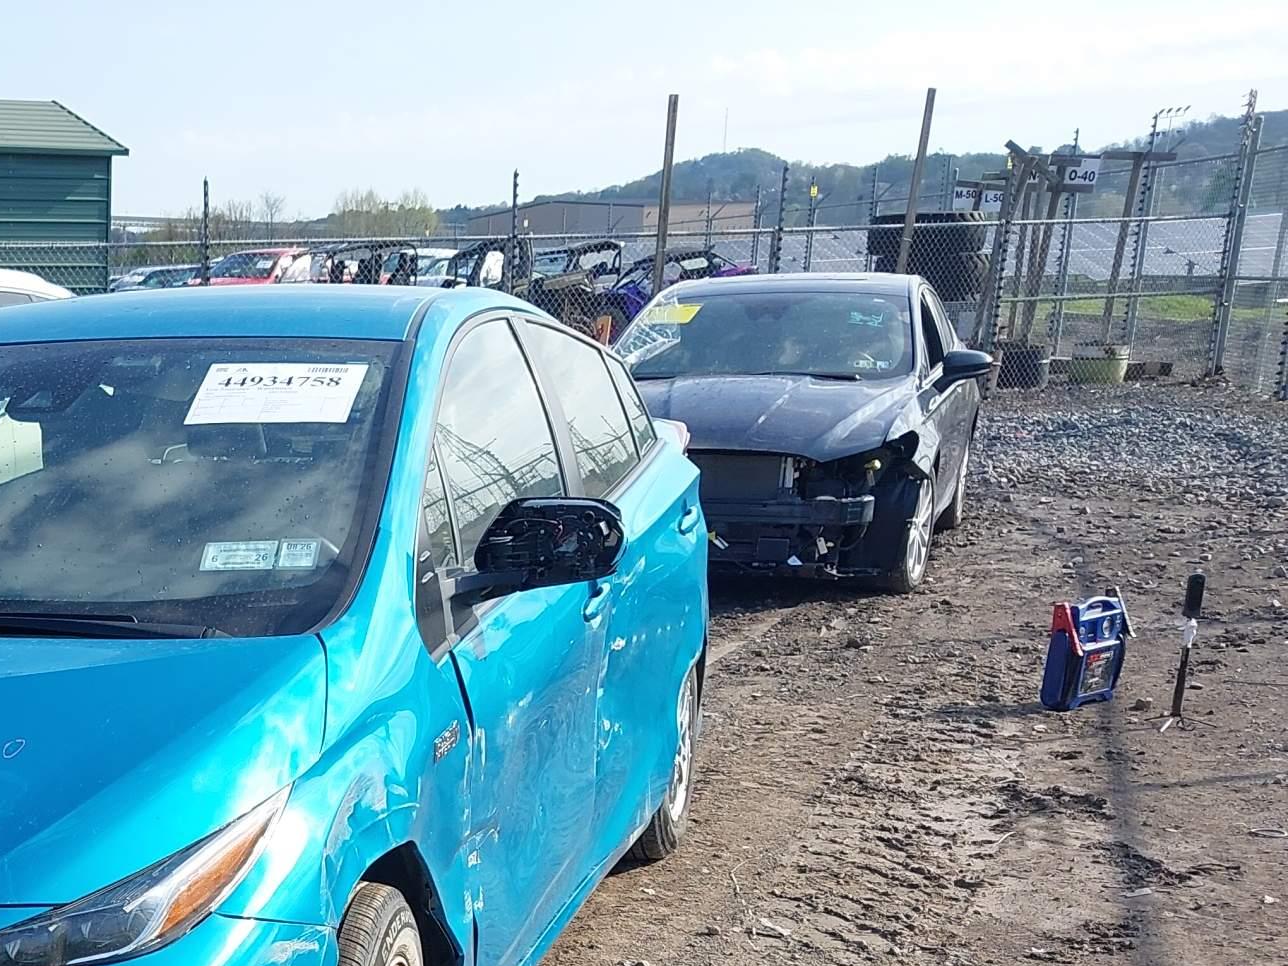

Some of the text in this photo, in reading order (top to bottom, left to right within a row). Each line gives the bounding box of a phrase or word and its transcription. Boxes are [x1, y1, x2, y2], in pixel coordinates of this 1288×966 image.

[1068, 169, 1096, 182] O-40
[955, 190, 977, 200] M-50
[219, 375, 342, 387] 44934758
[301, 543, 312, 551] 26
[254, 553, 268, 562] 26
